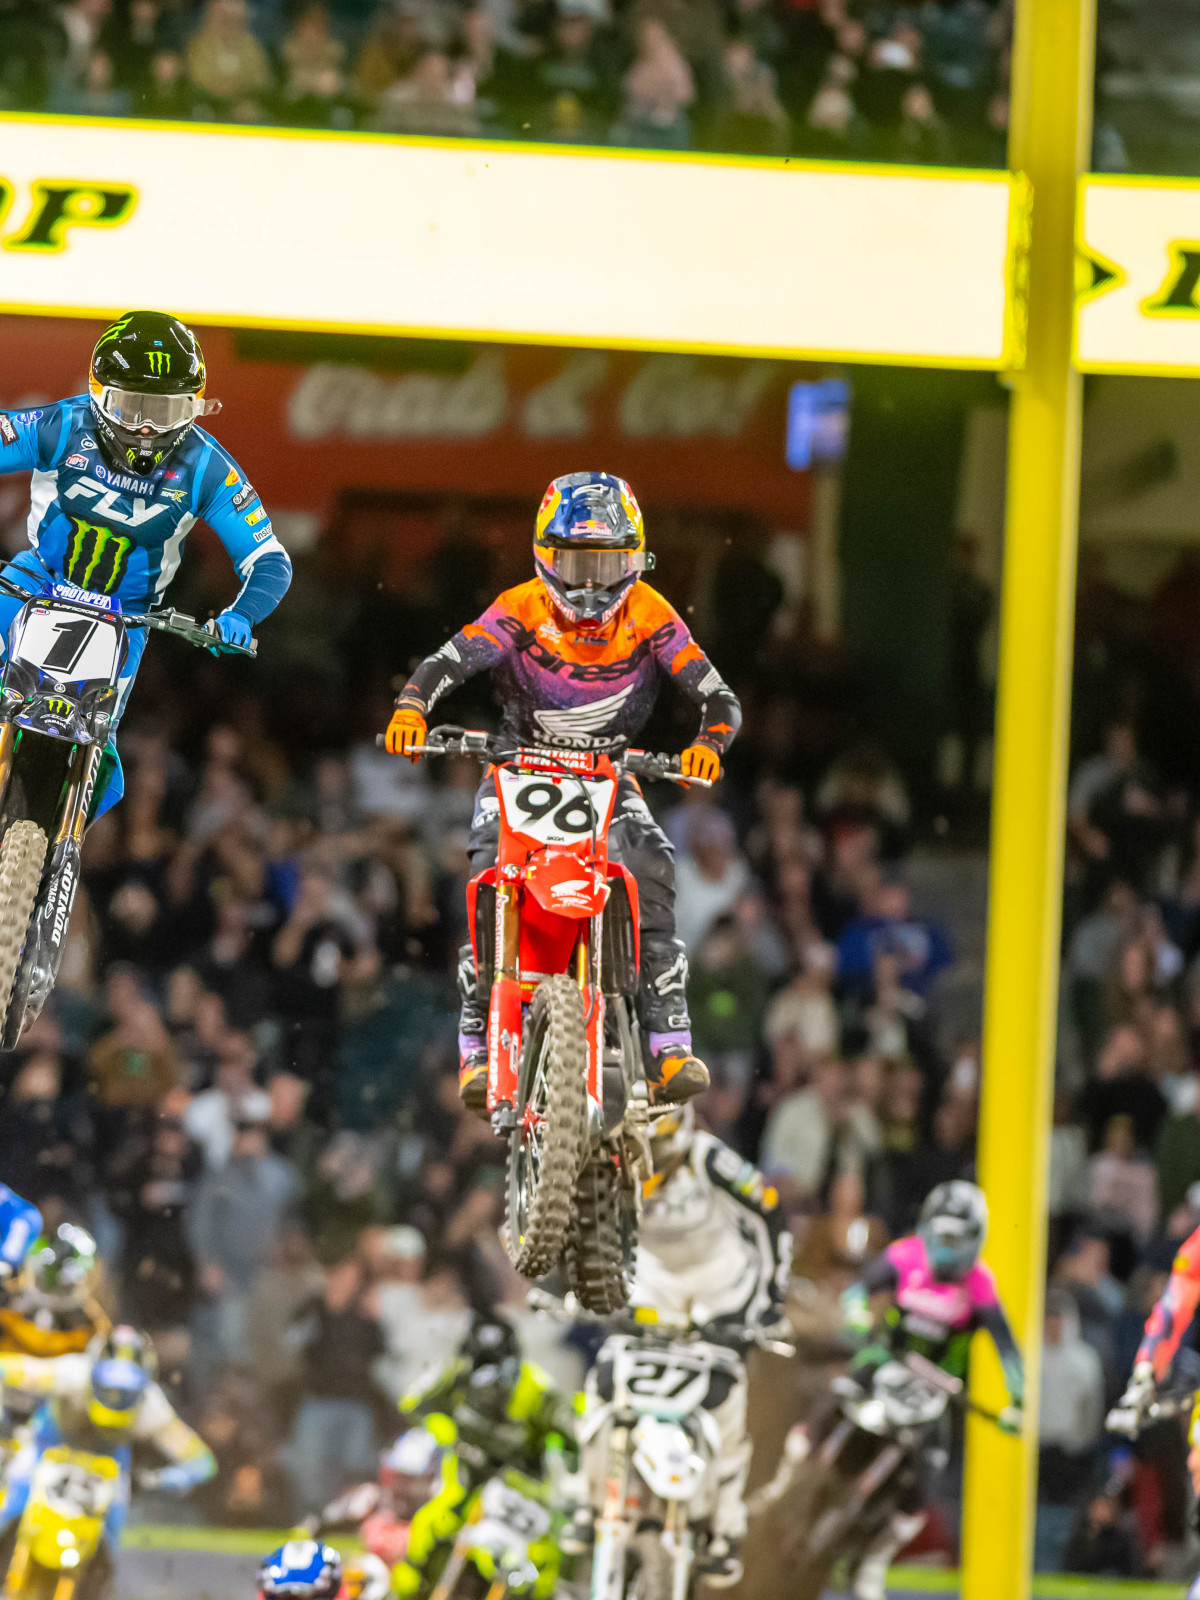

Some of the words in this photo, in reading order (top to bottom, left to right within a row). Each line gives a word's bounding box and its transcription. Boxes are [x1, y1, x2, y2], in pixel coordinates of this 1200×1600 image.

[64, 476, 170, 527] FLY
[106, 472, 155, 496] YAMAHA
[52, 586, 110, 609] PROTAPER
[40, 619, 100, 675] 1
[532, 728, 628, 749] HONDA
[516, 783, 599, 834] 96
[51, 862, 74, 947] DUNLOP
[490, 1010, 500, 1090] DUNLOP
[627, 1360, 702, 1397] 27
